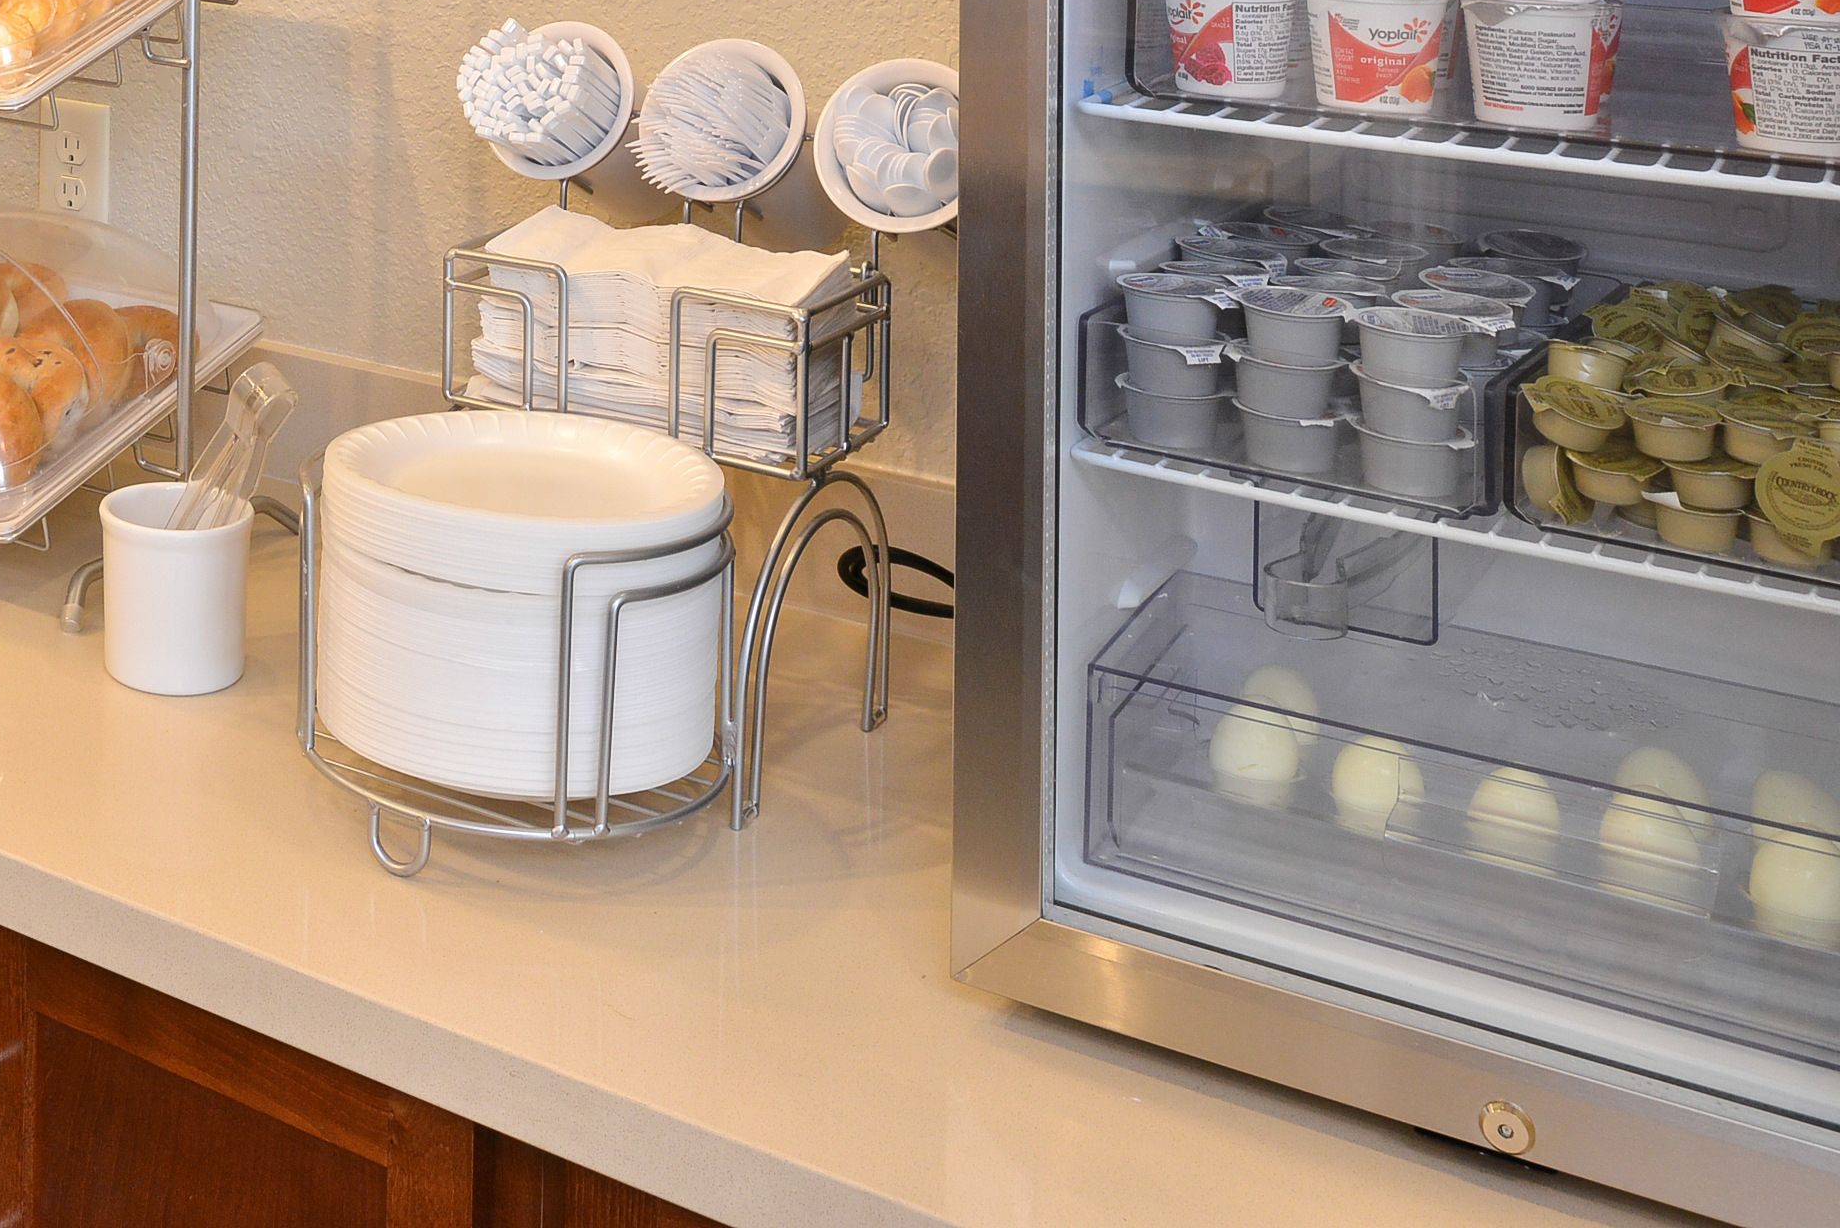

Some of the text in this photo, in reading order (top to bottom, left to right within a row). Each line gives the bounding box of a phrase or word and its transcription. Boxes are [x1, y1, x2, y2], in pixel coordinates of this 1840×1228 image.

[1509, 28, 1536, 36] Cultured
[1750, 48, 1807, 61] Nutrition
[1360, 57, 1407, 67] original
[1778, 92, 1832, 102] Carbohydrate
[1791, 114, 1831, 122] Phosphorus
